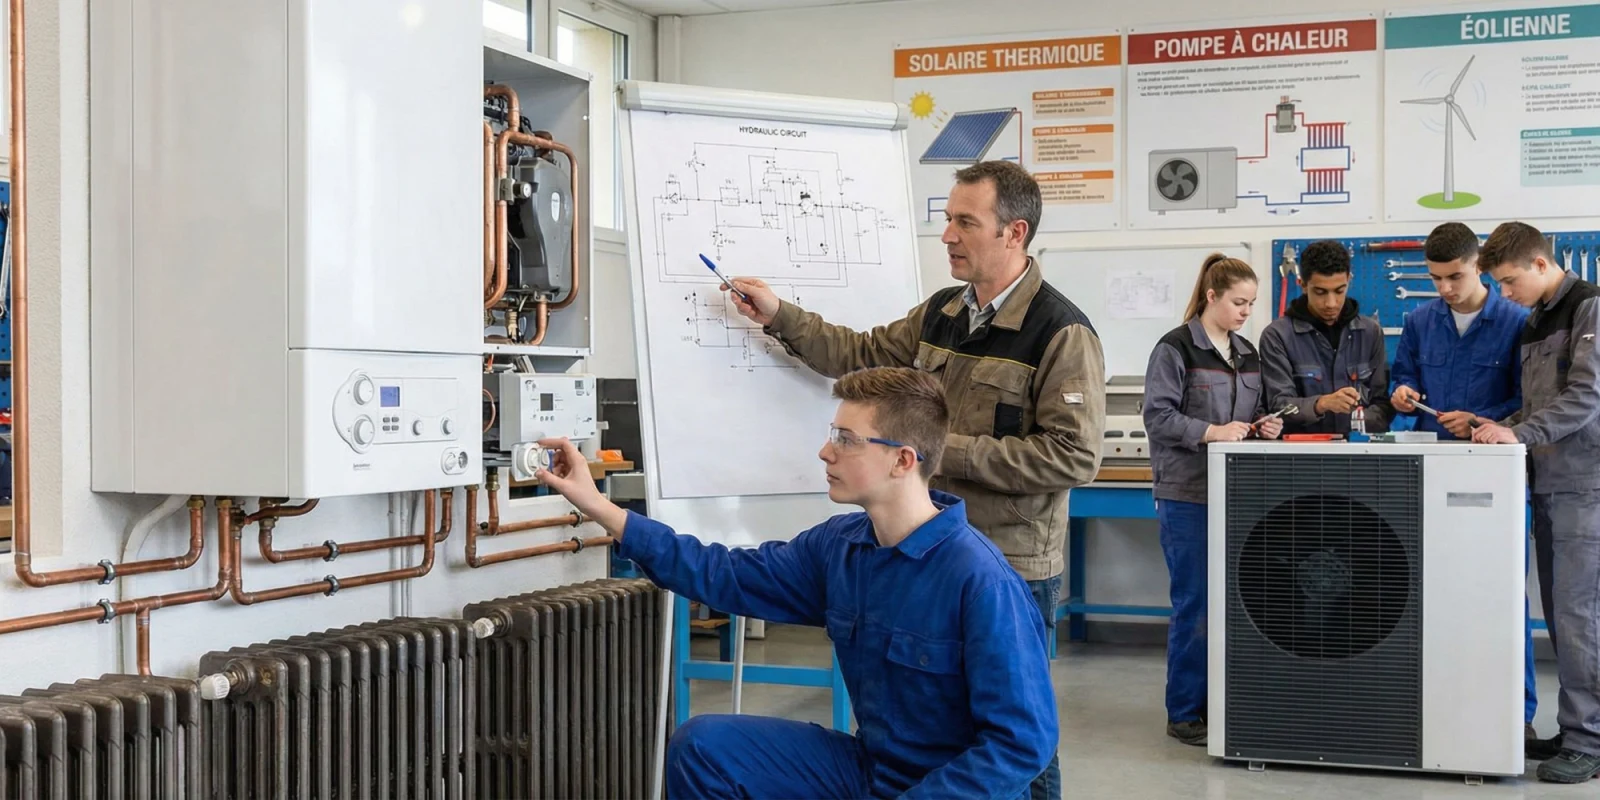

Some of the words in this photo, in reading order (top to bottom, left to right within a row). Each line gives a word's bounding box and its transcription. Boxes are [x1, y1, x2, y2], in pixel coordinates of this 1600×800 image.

[1460, 14, 1571, 40] ÉOLIENNE
[1154, 35, 1225, 58] POMPE
[1231, 30, 1246, 54] À
[1252, 28, 1349, 53] CHALEUR
[909, 50, 988, 73] SOLAIRE
[992, 43, 1105, 67] THERMIQUE
[739, 126, 779, 136] HYDRAULIC
[780, 129, 807, 138] CIRCUIT
